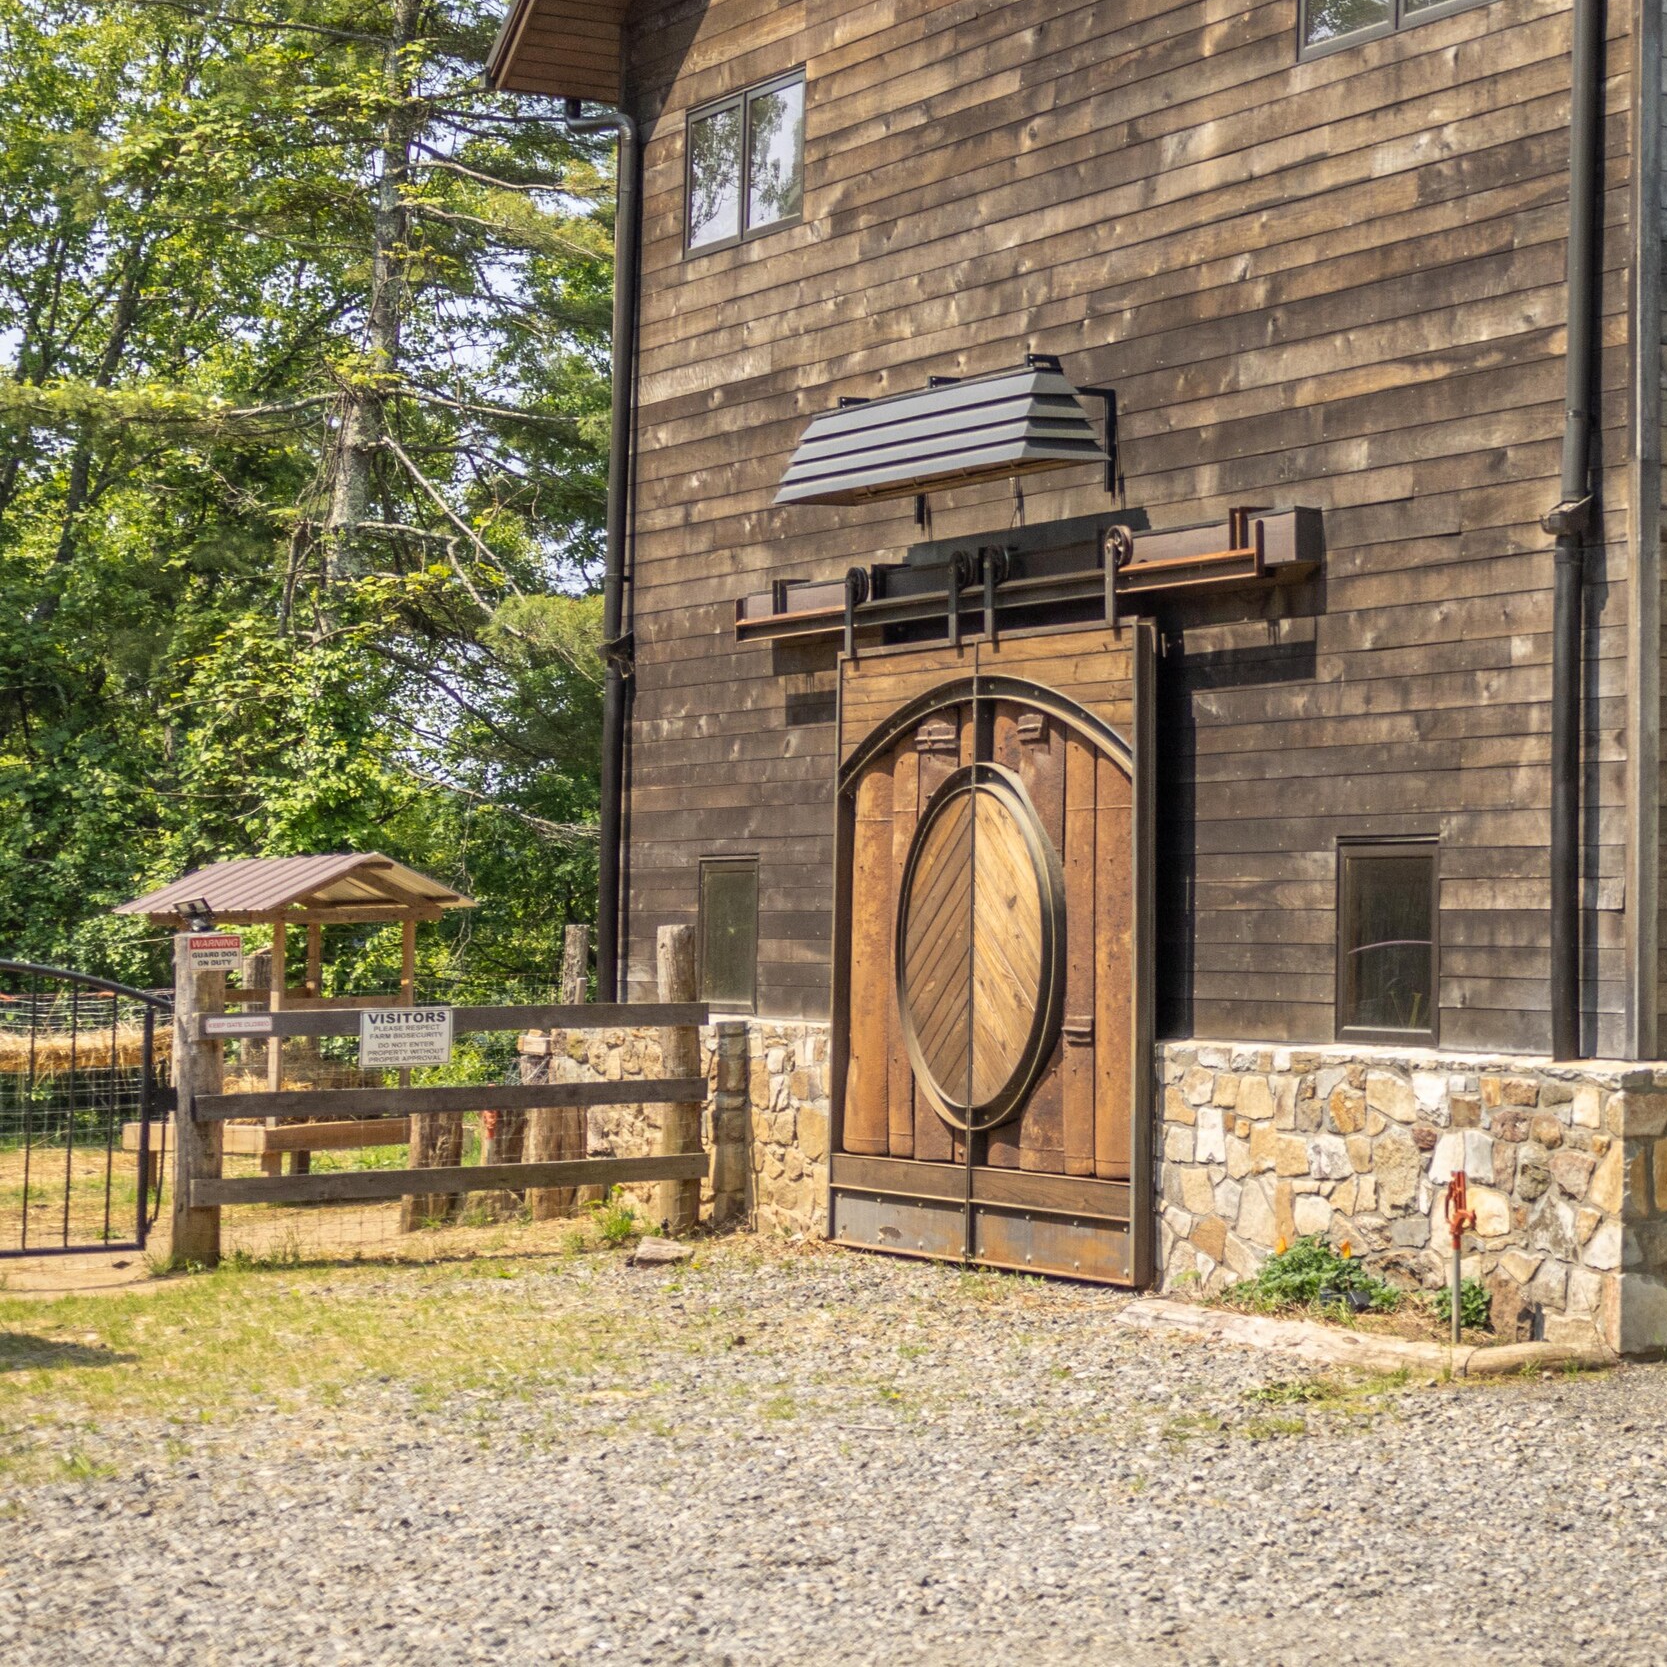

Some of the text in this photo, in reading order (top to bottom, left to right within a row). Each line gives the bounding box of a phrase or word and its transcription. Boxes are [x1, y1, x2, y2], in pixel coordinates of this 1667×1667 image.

[191, 937, 239, 949] WARNING
[192, 950, 238, 959] GUARD DOG
[368, 1012, 446, 1024] VISITORS
